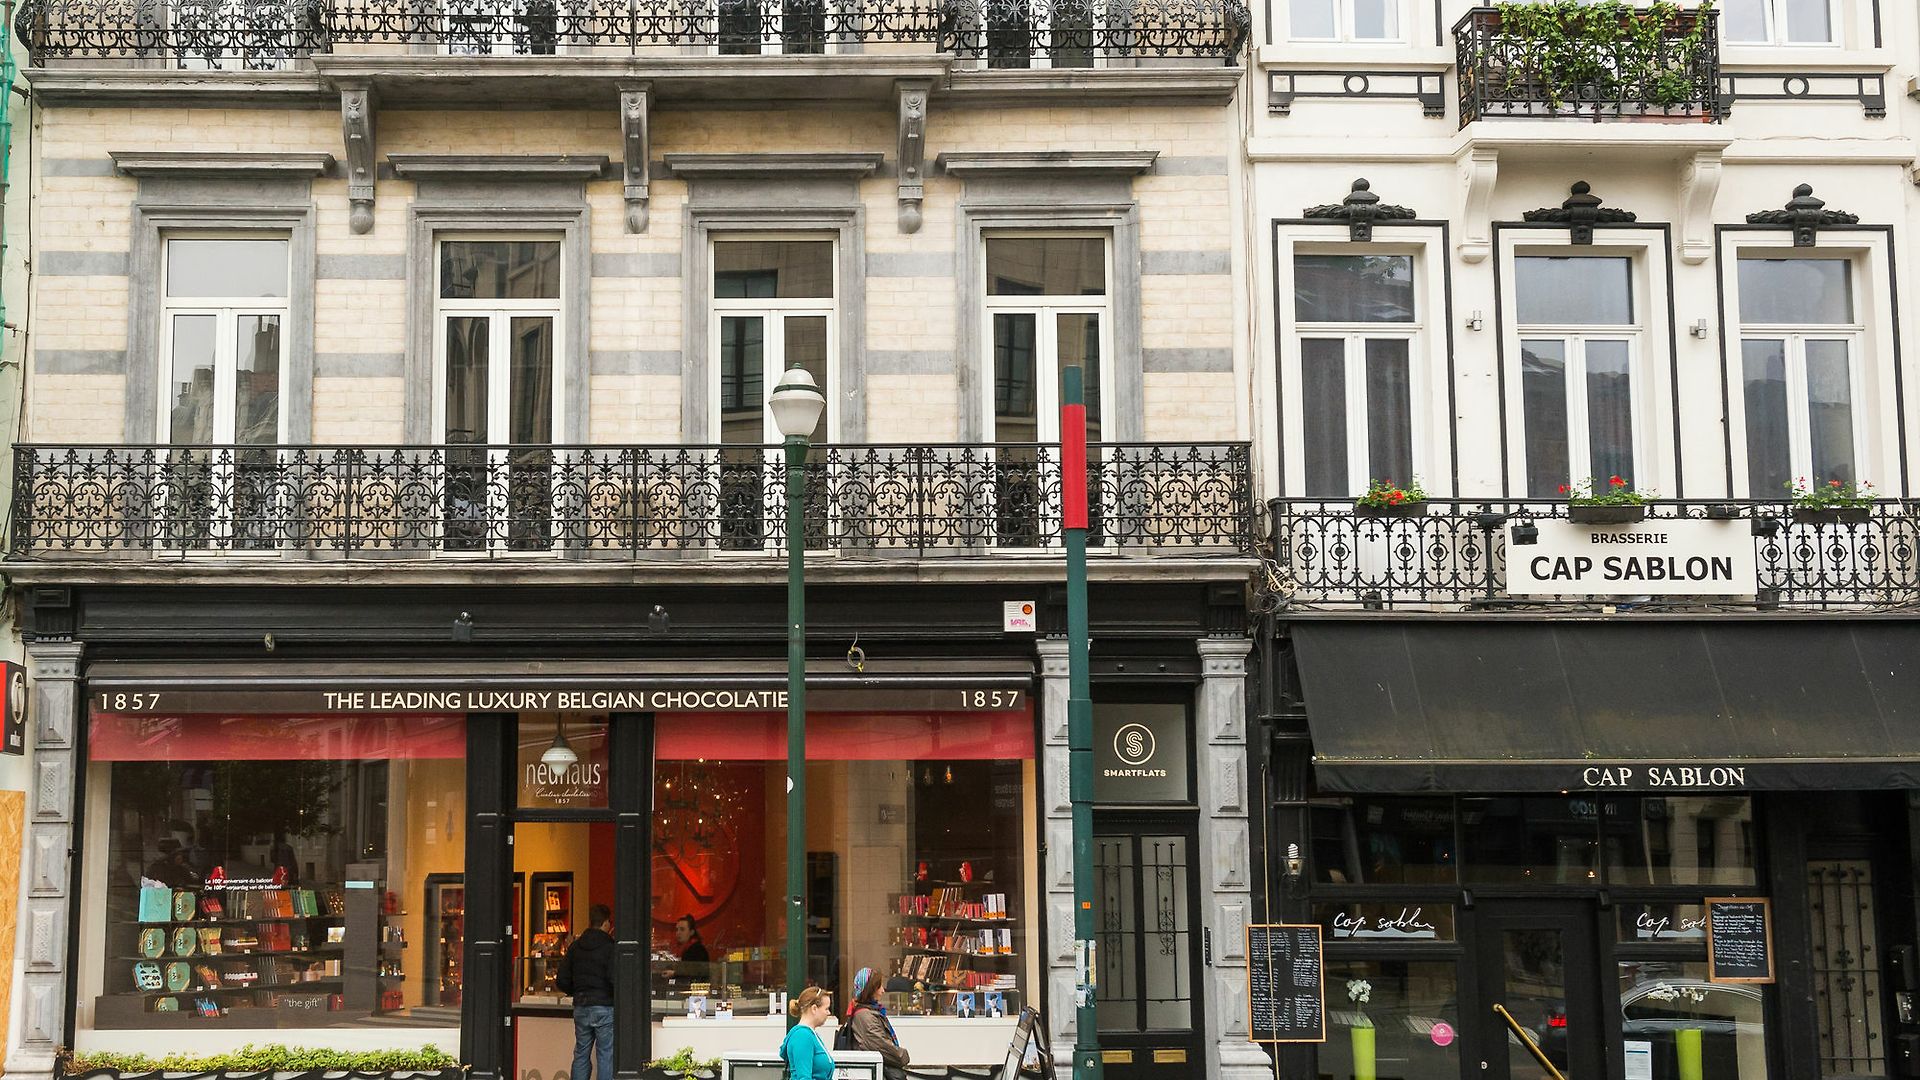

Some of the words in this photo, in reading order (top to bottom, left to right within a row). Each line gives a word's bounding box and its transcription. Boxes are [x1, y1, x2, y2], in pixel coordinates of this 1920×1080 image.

[1591, 533, 1668, 544] BRASSERIE
[1530, 556, 1593, 581] CAP
[1603, 556, 1733, 581] SABLON
[101, 693, 161, 710] 1857
[323, 692, 364, 709] THE
[370, 692, 461, 709] LEADING
[468, 692, 552, 709] LUXURY
[558, 691, 644, 709] BELGIAN
[651, 690, 789, 708] CHOCOLATIE
[961, 690, 1019, 707] 1857
[1104, 769, 1167, 777] SMARTFLATS
[1583, 767, 1633, 786] CAP
[1648, 767, 1746, 786] SABLON
